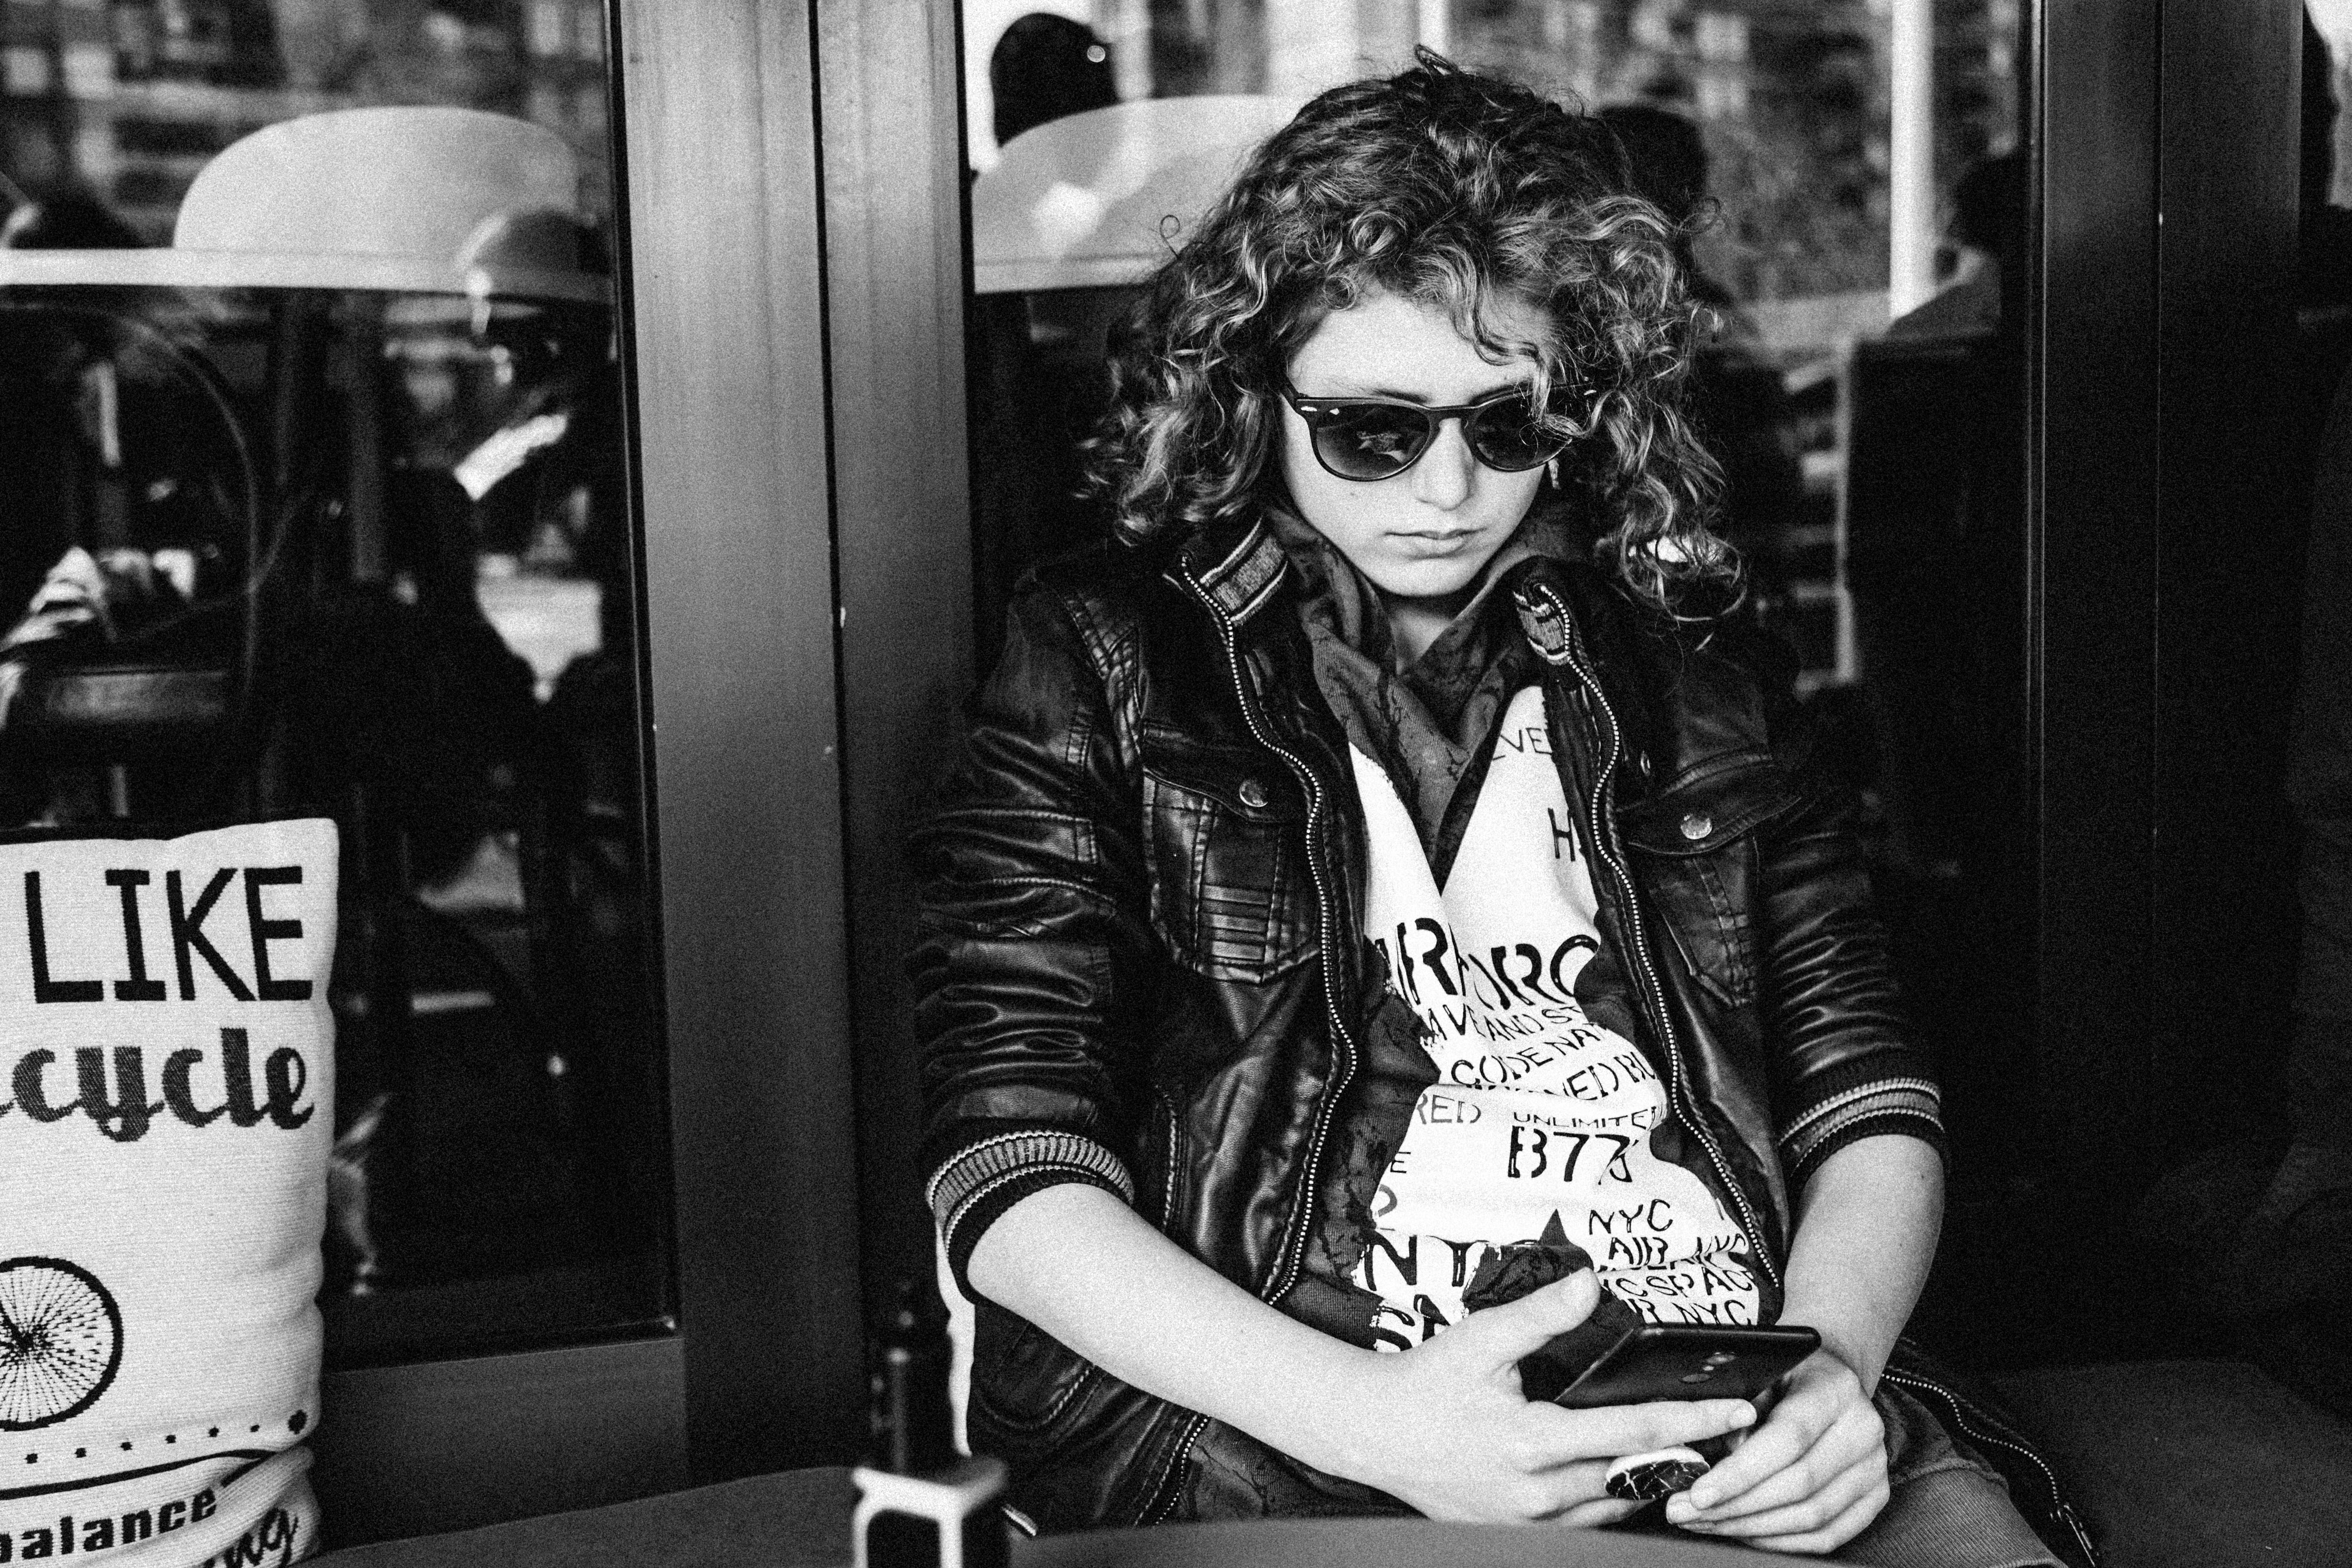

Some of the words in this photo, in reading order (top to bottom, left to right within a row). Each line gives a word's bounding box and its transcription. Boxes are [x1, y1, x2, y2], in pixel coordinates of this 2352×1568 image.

[1493, 727, 1552, 761] VE
[24, 866, 313, 1003] LIKE
[0, 1028, 315, 1142] cycle
[1451, 1046, 1554, 1087] CODE
[1589, 1198, 1673, 1236] NYC
